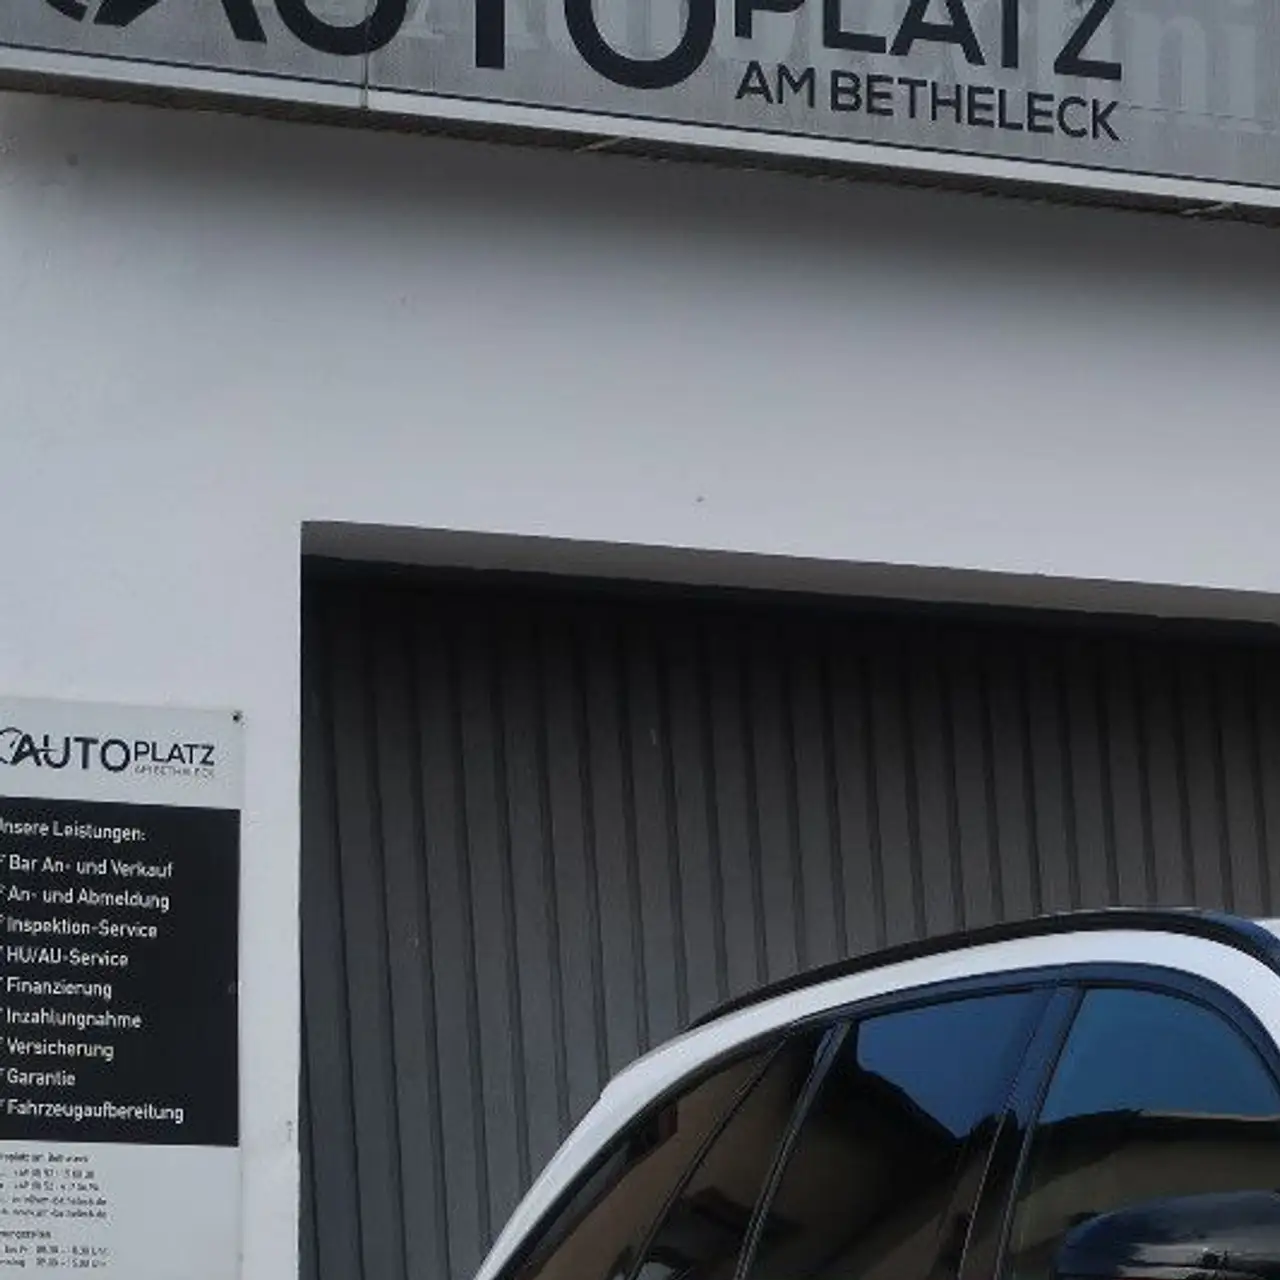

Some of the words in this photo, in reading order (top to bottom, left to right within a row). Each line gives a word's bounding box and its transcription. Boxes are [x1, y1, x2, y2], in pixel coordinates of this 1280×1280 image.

[736, 61, 816, 107] AM
[829, 71, 1122, 141] BETHELECK
[10, 733, 215, 772] AUTOPLATZ
[53, 820, 146, 843] Leistungen:
[9, 854, 38, 871] Bar
[41, 856, 71, 873] An-
[76, 859, 107, 875] und
[110, 859, 173, 878] Verkauf
[8, 885, 37, 901] An-
[43, 887, 73, 904] und
[77, 888, 169, 913] Abmeldung
[7, 917, 157, 938] Inspektion-Service
[7, 977, 112, 1000] Finanzierung
[7, 1007, 142, 1031] Inzahlungnahme
[7, 1037, 114, 1062] Versicherung
[7, 1068, 76, 1086] Garantie
[7, 1099, 184, 1124] Fahrzeugaufbereitung
